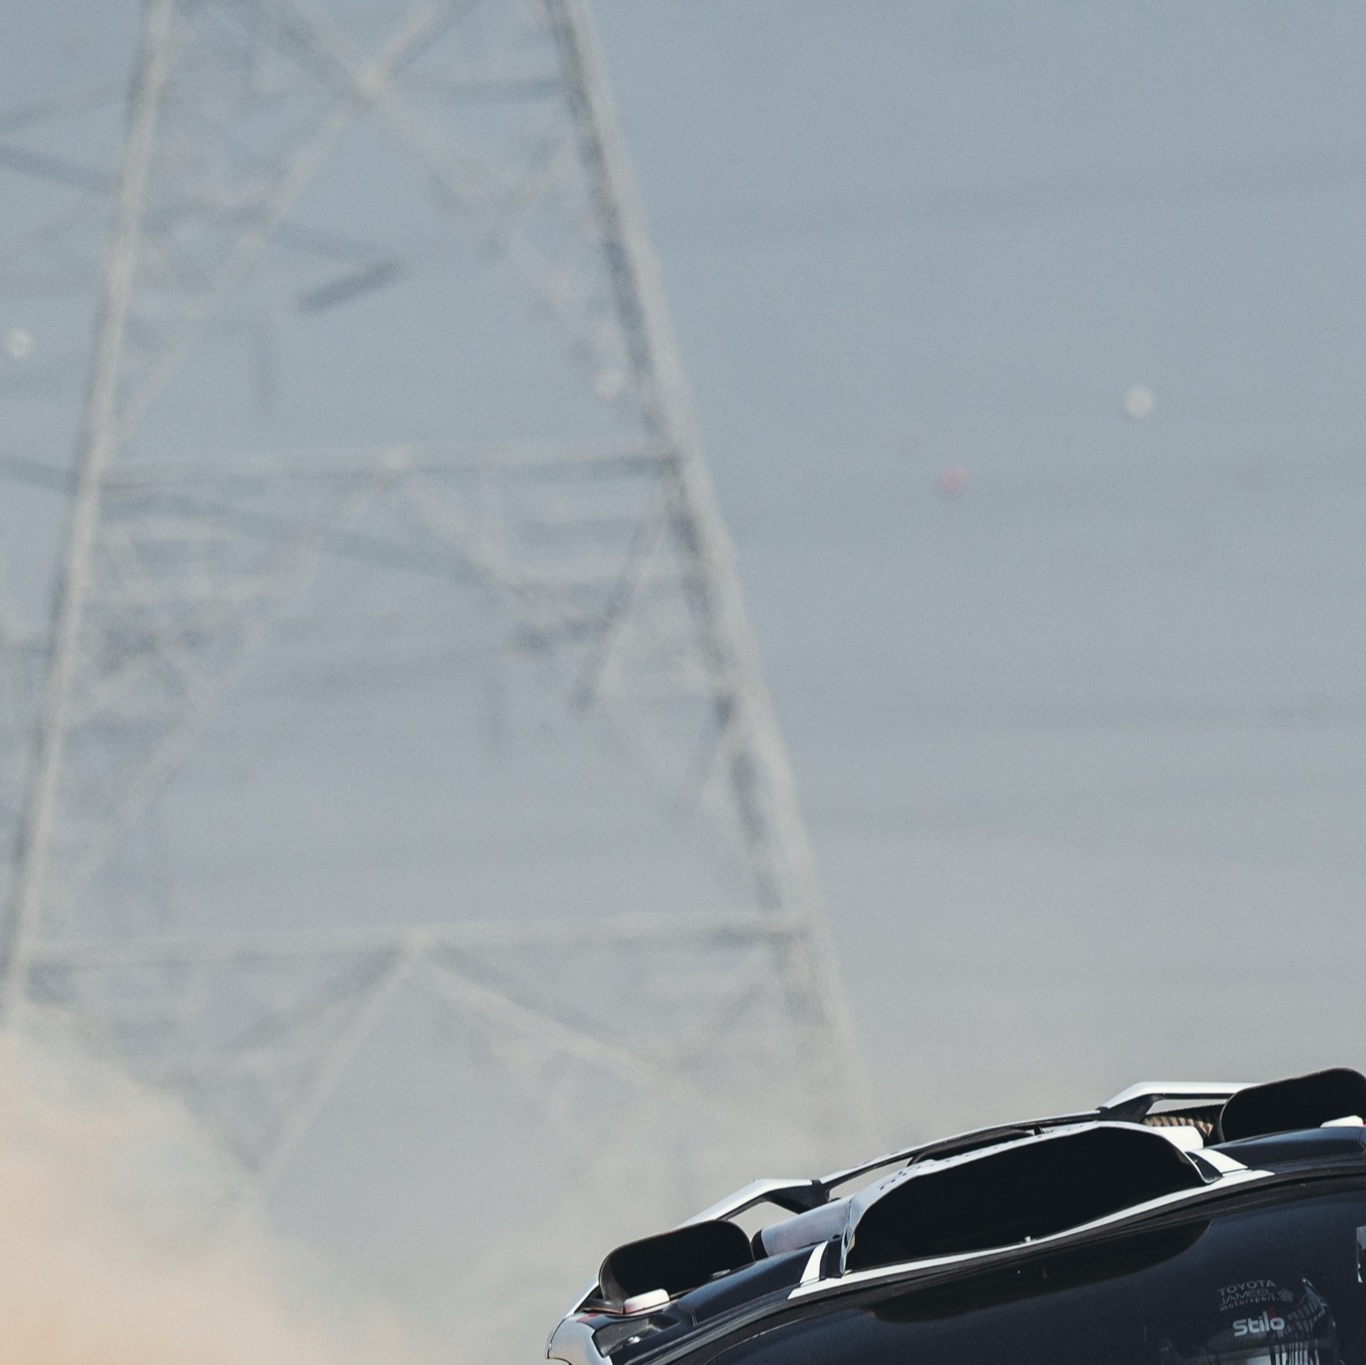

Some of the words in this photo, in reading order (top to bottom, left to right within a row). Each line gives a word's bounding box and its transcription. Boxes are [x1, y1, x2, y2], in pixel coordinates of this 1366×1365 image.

[1217, 1279, 1276, 1296] TOYOTA
[1219, 1288, 1273, 1307] JAMEEL
[1233, 1311, 1285, 1336] Stilo
